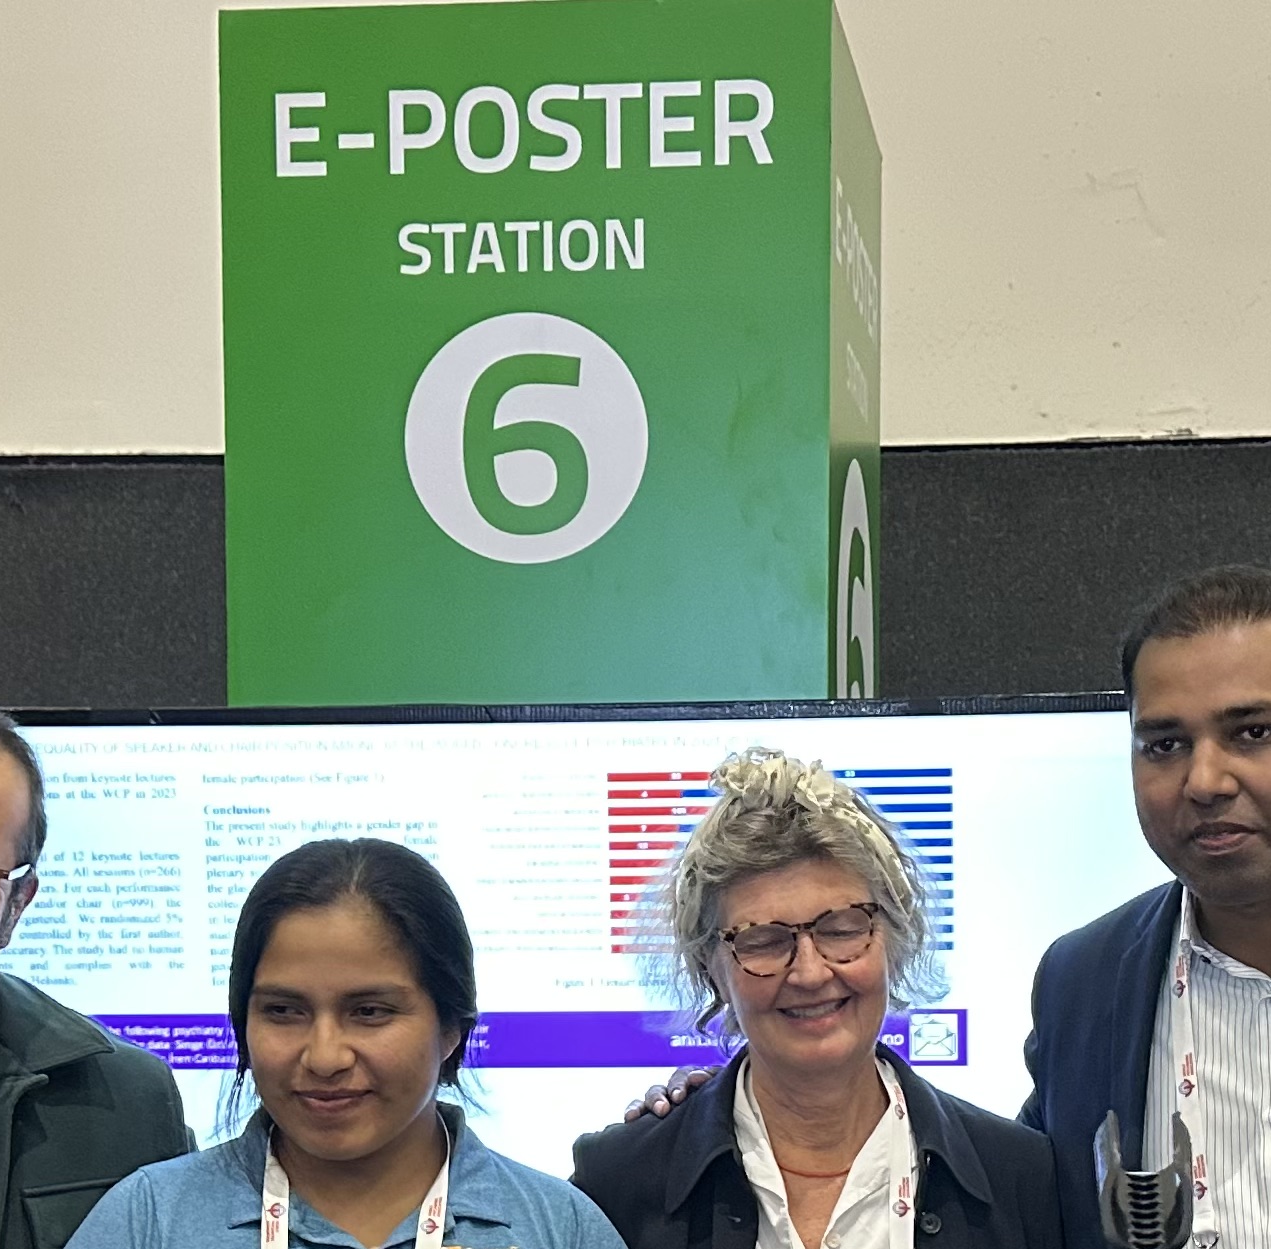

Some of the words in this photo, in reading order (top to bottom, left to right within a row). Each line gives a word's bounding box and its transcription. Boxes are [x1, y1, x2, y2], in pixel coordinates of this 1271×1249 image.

[274, 79, 774, 177] E-POSTER
[398, 218, 645, 275] STATION
[463, 353, 589, 536] 6
[203, 804, 271, 815] Conclusions
